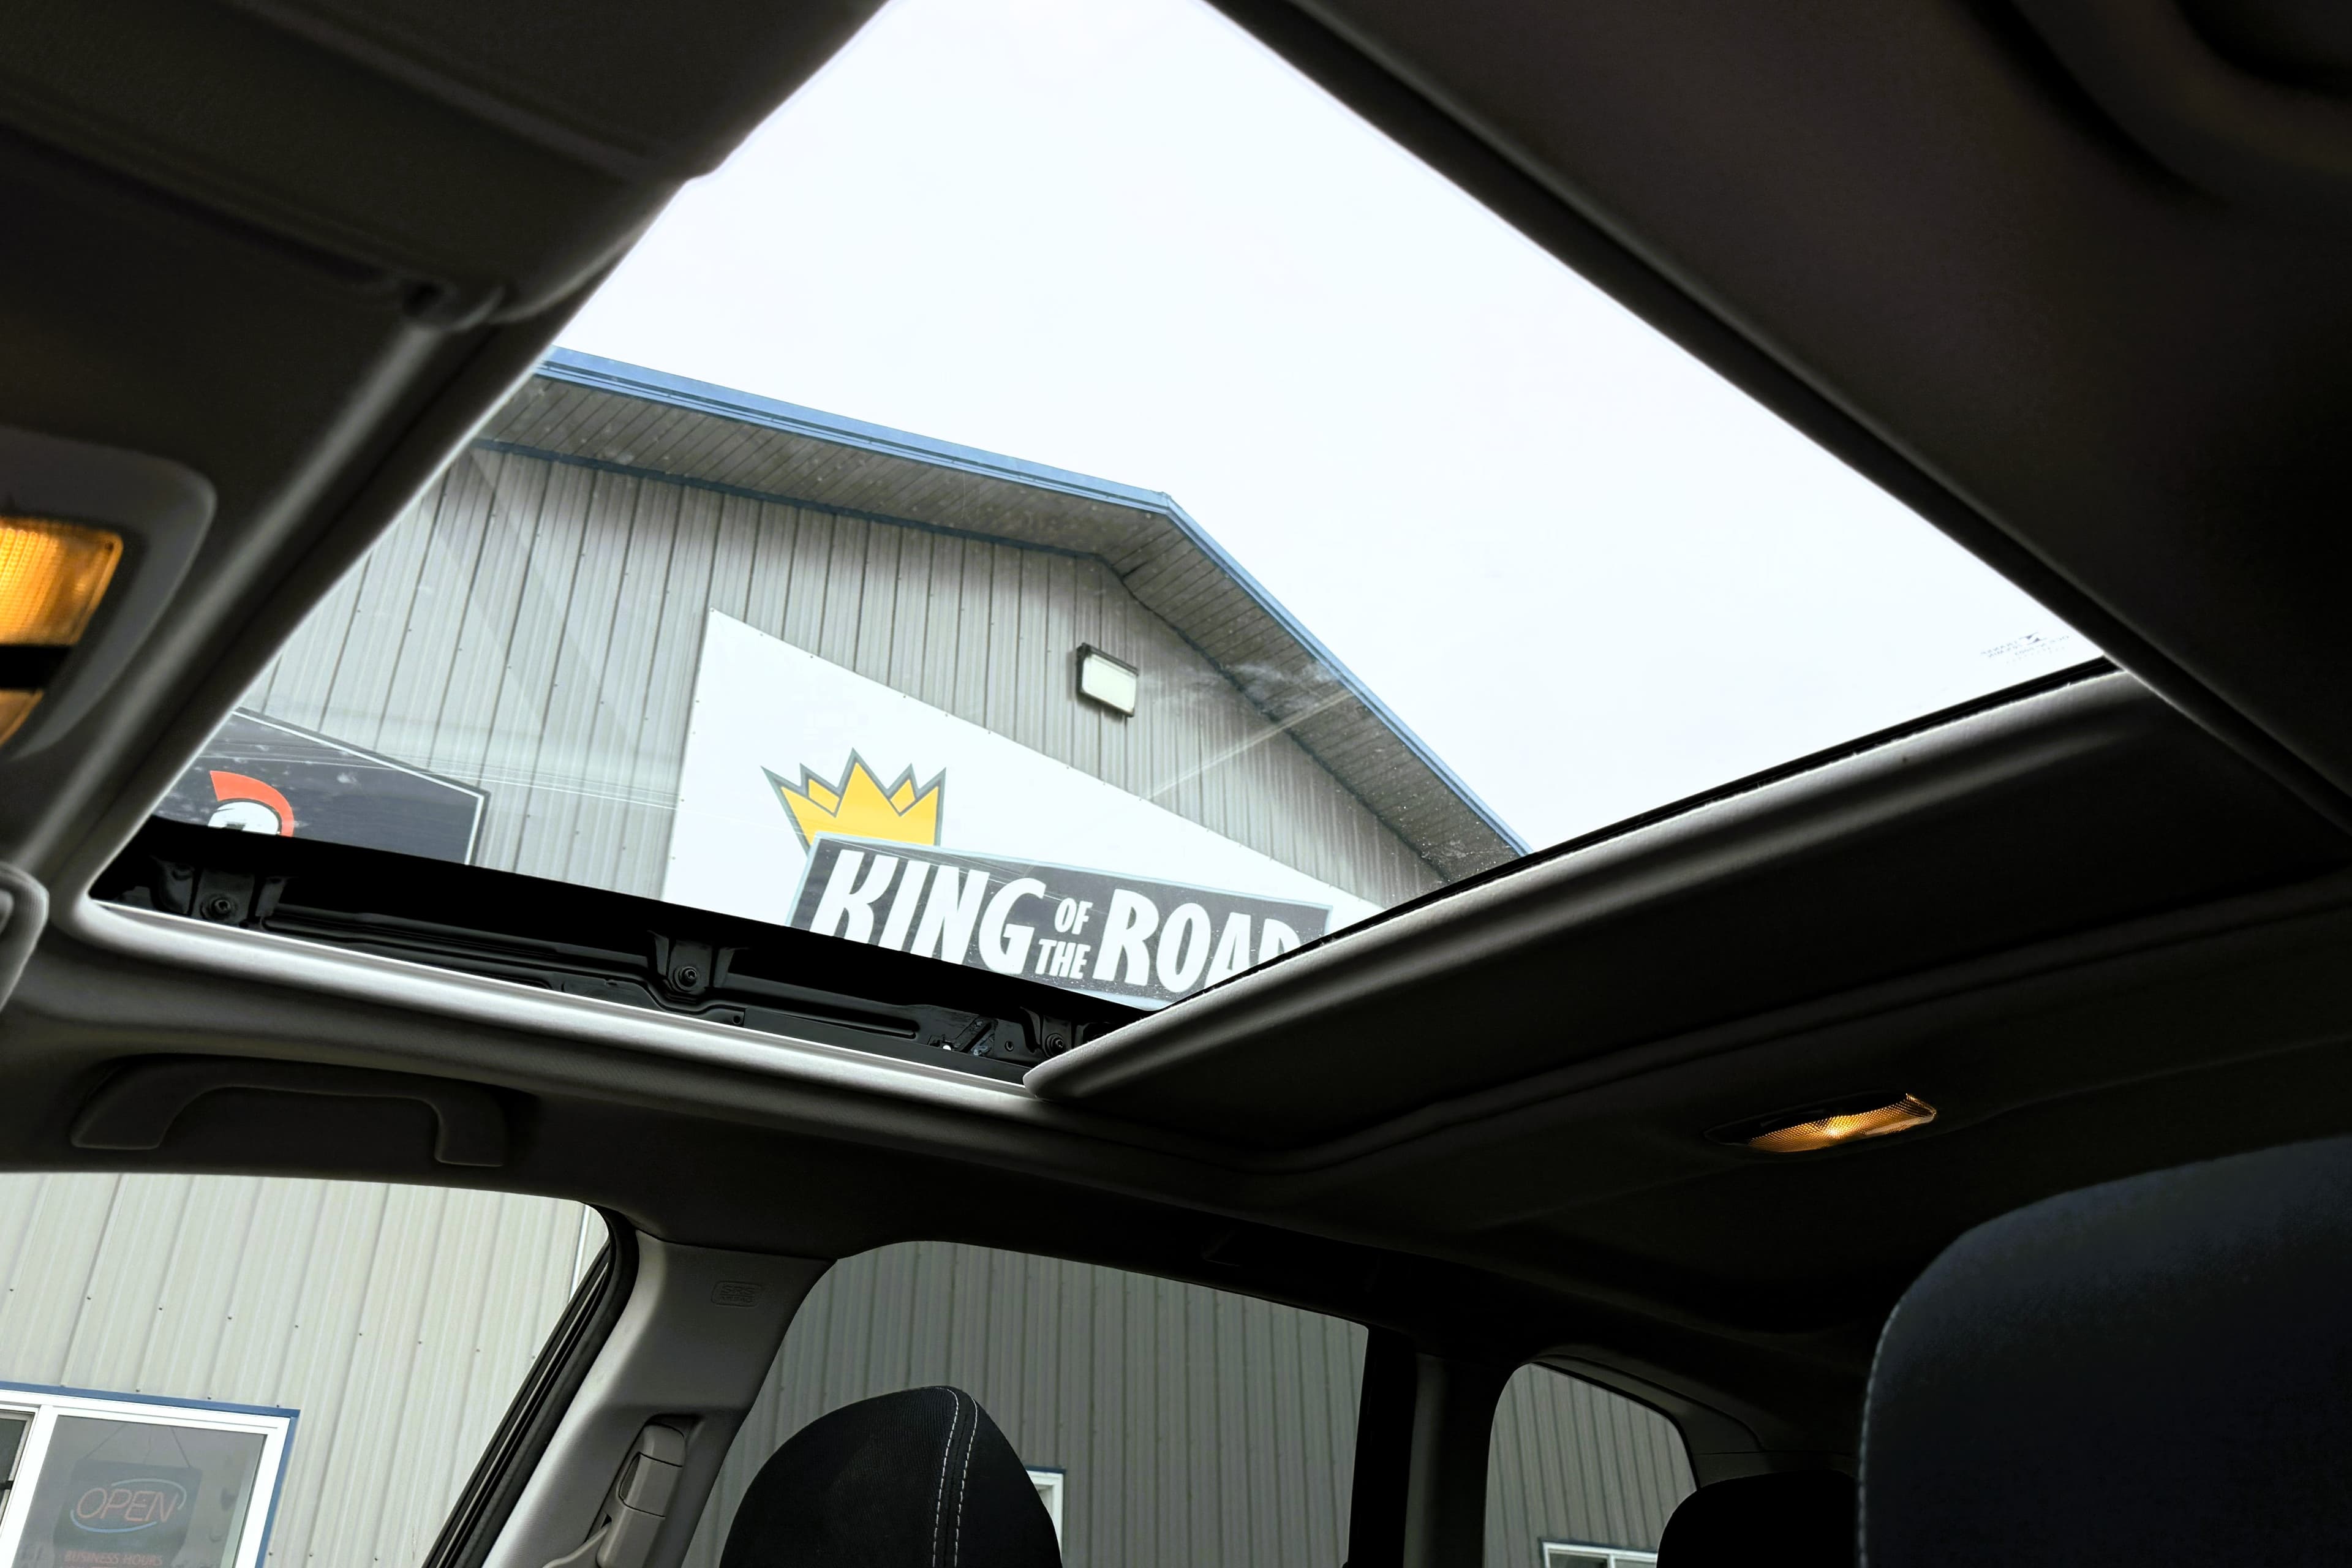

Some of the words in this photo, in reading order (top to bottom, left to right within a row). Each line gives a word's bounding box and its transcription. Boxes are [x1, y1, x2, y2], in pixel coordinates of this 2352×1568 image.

[809, 849, 1047, 974] KING
[1054, 897, 1093, 935] OF
[1035, 939, 1091, 979] THE
[76, 1487, 178, 1522] OPEN
[64, 1550, 119, 1564] BUSINESS
[123, 1553, 163, 1566] HOURS
